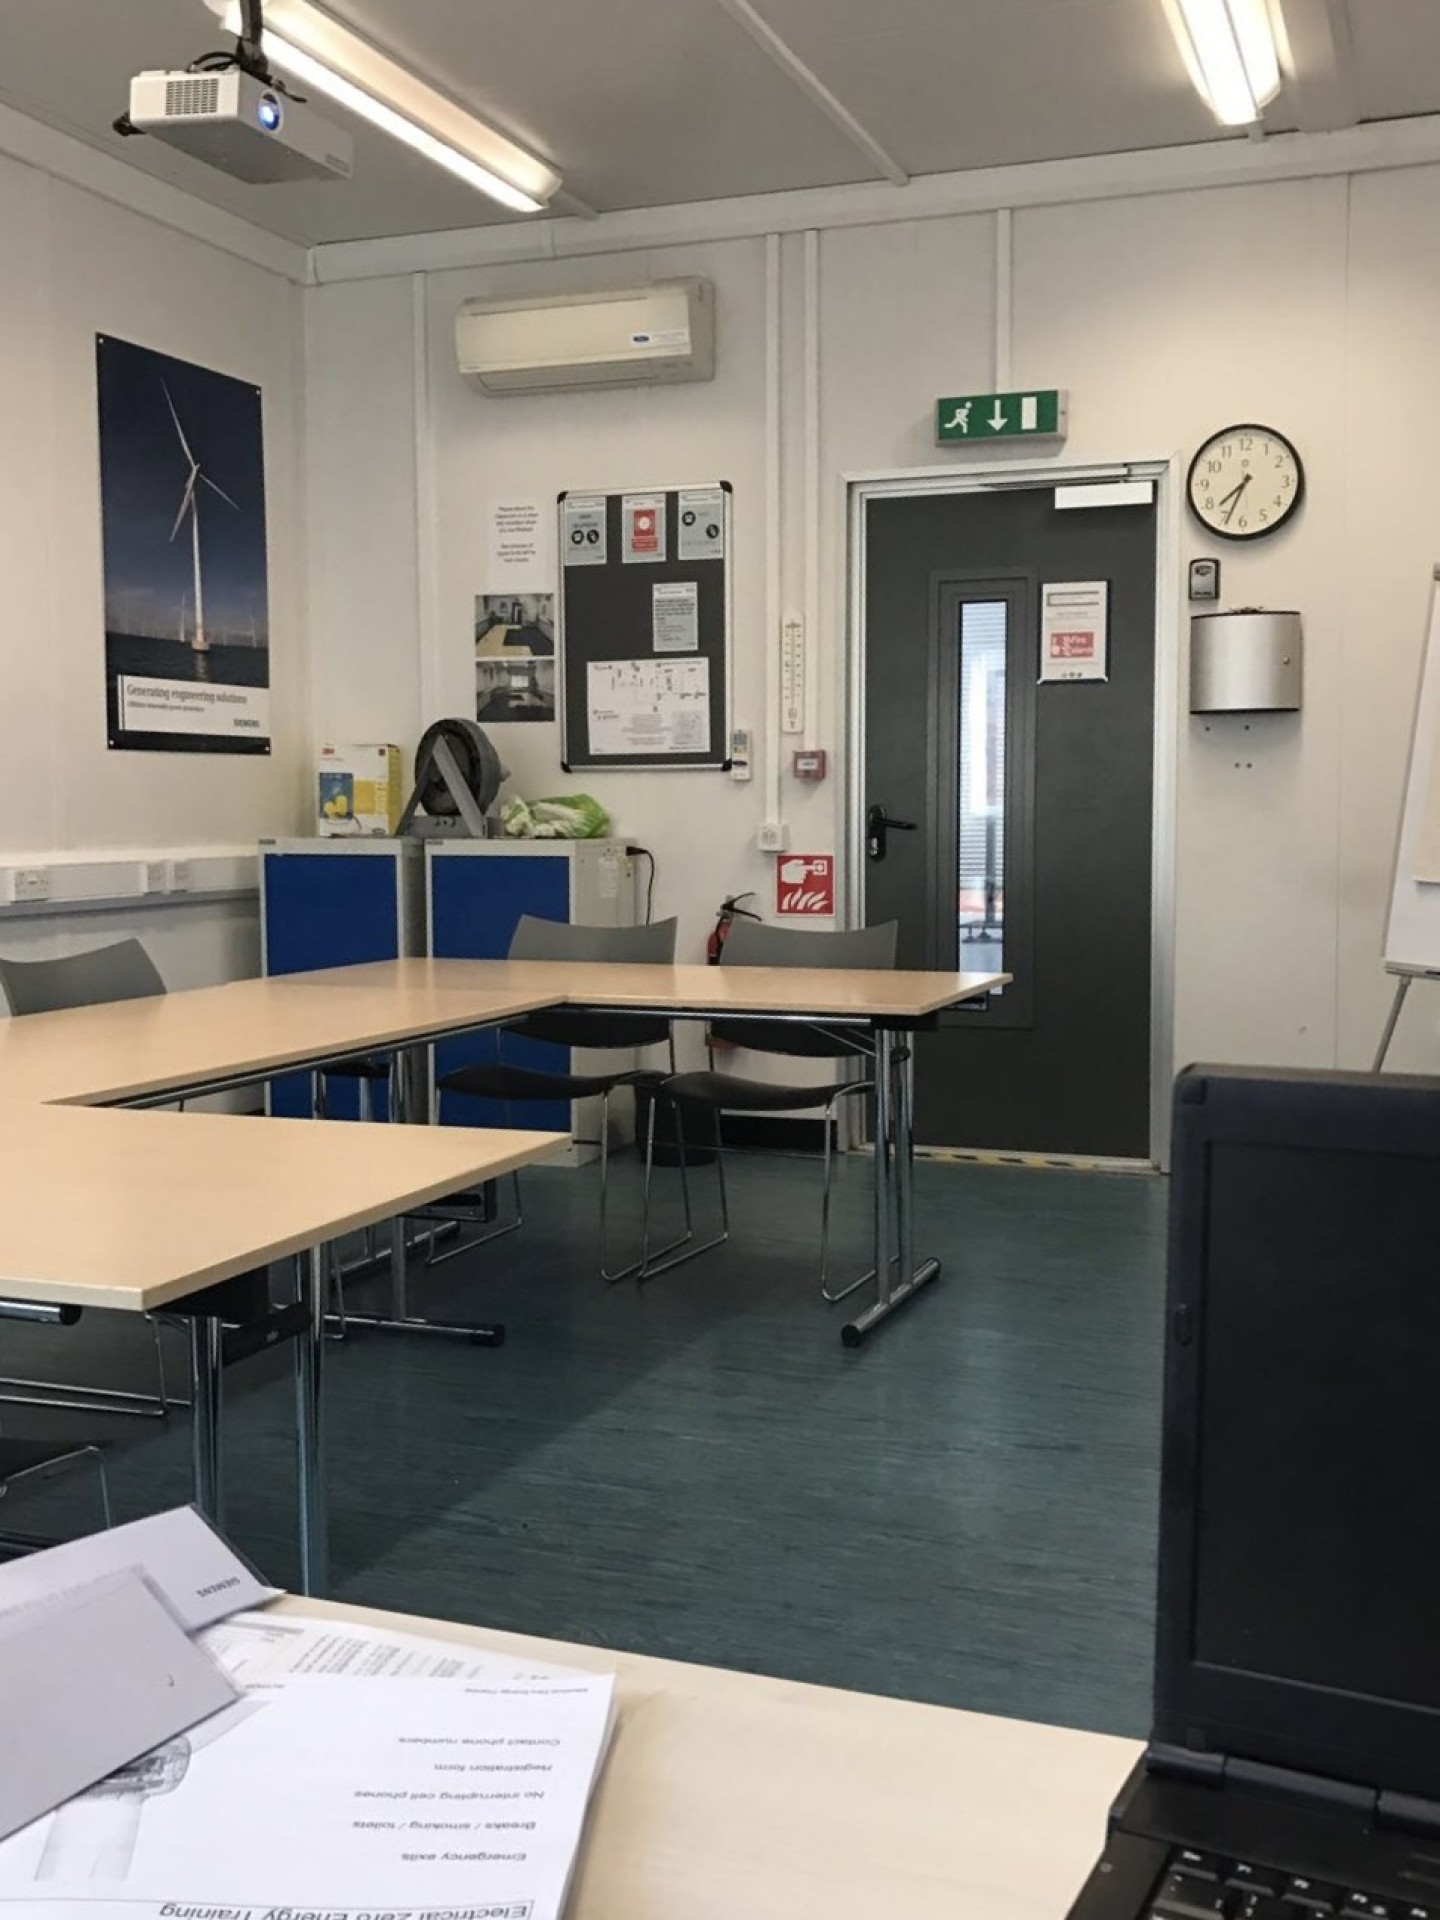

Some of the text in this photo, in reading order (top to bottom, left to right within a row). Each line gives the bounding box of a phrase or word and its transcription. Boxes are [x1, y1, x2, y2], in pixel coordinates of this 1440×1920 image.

[1239, 437, 1254, 451] 12
[1221, 445, 1233, 457] 11
[1207, 460, 1222, 472] 10
[1274, 455, 1284, 469] 2
[1200, 478, 1210, 491] 9
[1281, 474, 1290, 488] 3
[1205, 497, 1214, 510] 8
[1273, 494, 1282, 508] 4
[1258, 508, 1268, 521] 5
[1238, 515, 1248, 528] 6
[127, 684, 247, 704] Generating engineering solutions
[398, 1737, 561, 1747] Contact phone numbers
[433, 1763, 553, 1774] Registration form
[353, 1790, 545, 1802] No interrupting cell phones
[352, 1820, 396, 1830] toilets
[408, 1821, 472, 1831] smoking
[484, 1822, 537, 1831] Breaks
[400, 1851, 527, 1863] Emergency exits
[158, 1903, 254, 1920] Training
